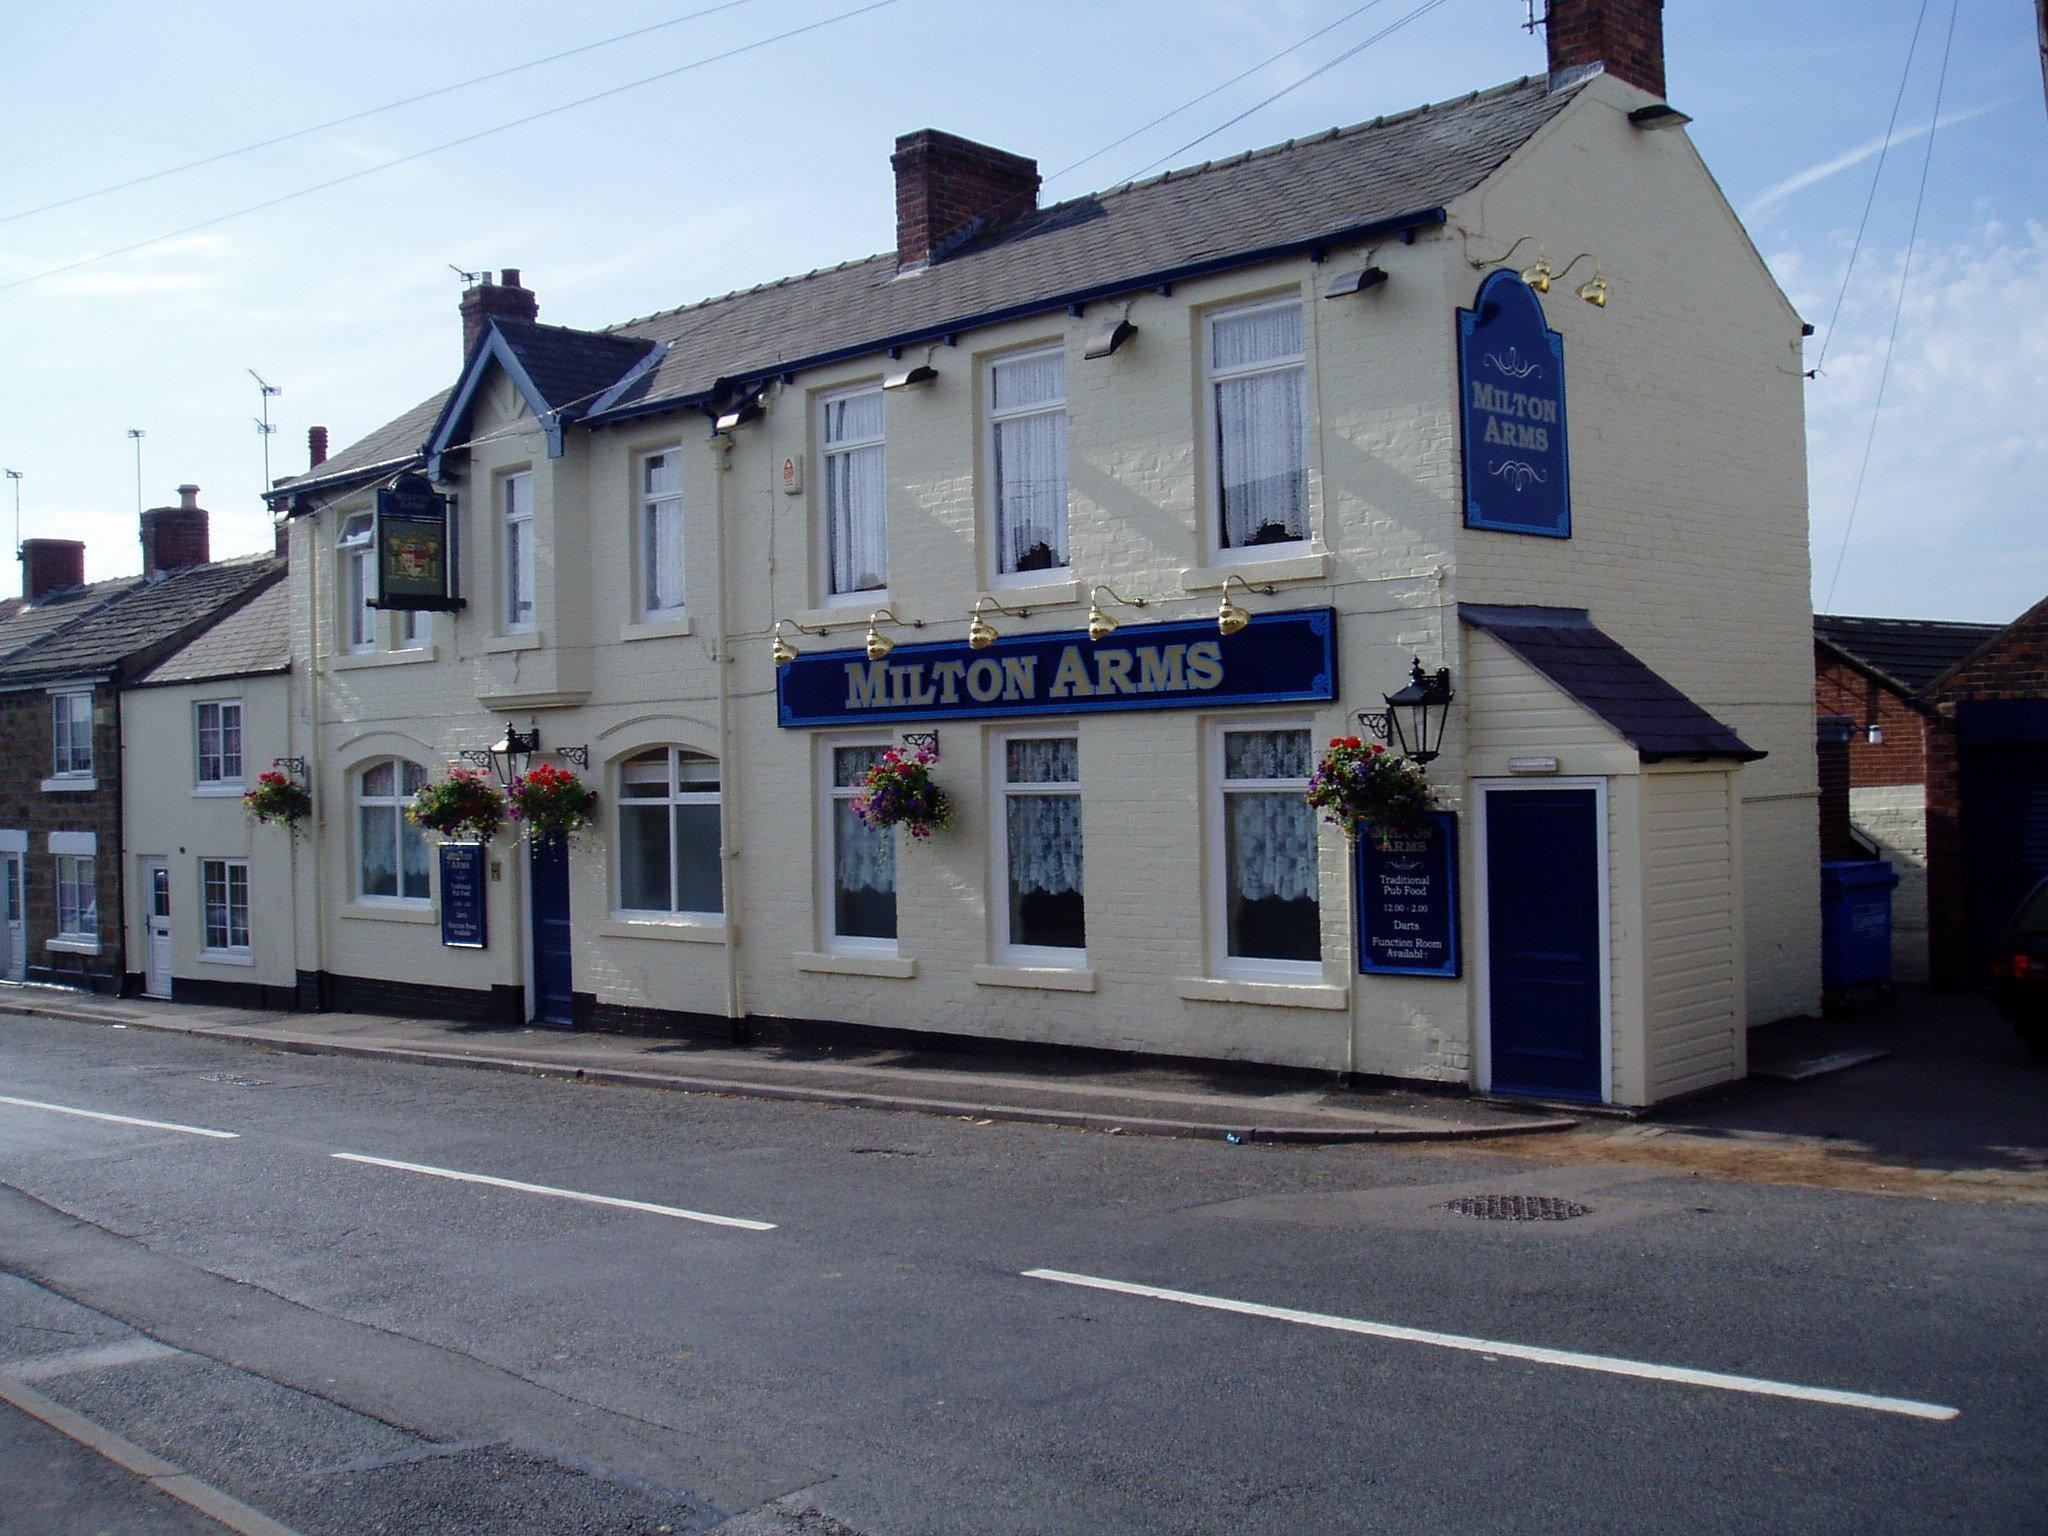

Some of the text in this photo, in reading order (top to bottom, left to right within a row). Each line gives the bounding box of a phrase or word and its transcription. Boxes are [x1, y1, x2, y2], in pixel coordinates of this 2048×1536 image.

[1471, 380, 1557, 424] MILTON
[1484, 416, 1549, 452] ARMS
[845, 641, 1224, 710] MILTON ARMS
[1380, 841, 1427, 852] ARMS
[1379, 874, 1430, 885] Traditional
[1384, 886, 1427, 896] Pub Food
[1393, 920, 1420, 930] Darts
[1372, 937, 1442, 949] Function Room
